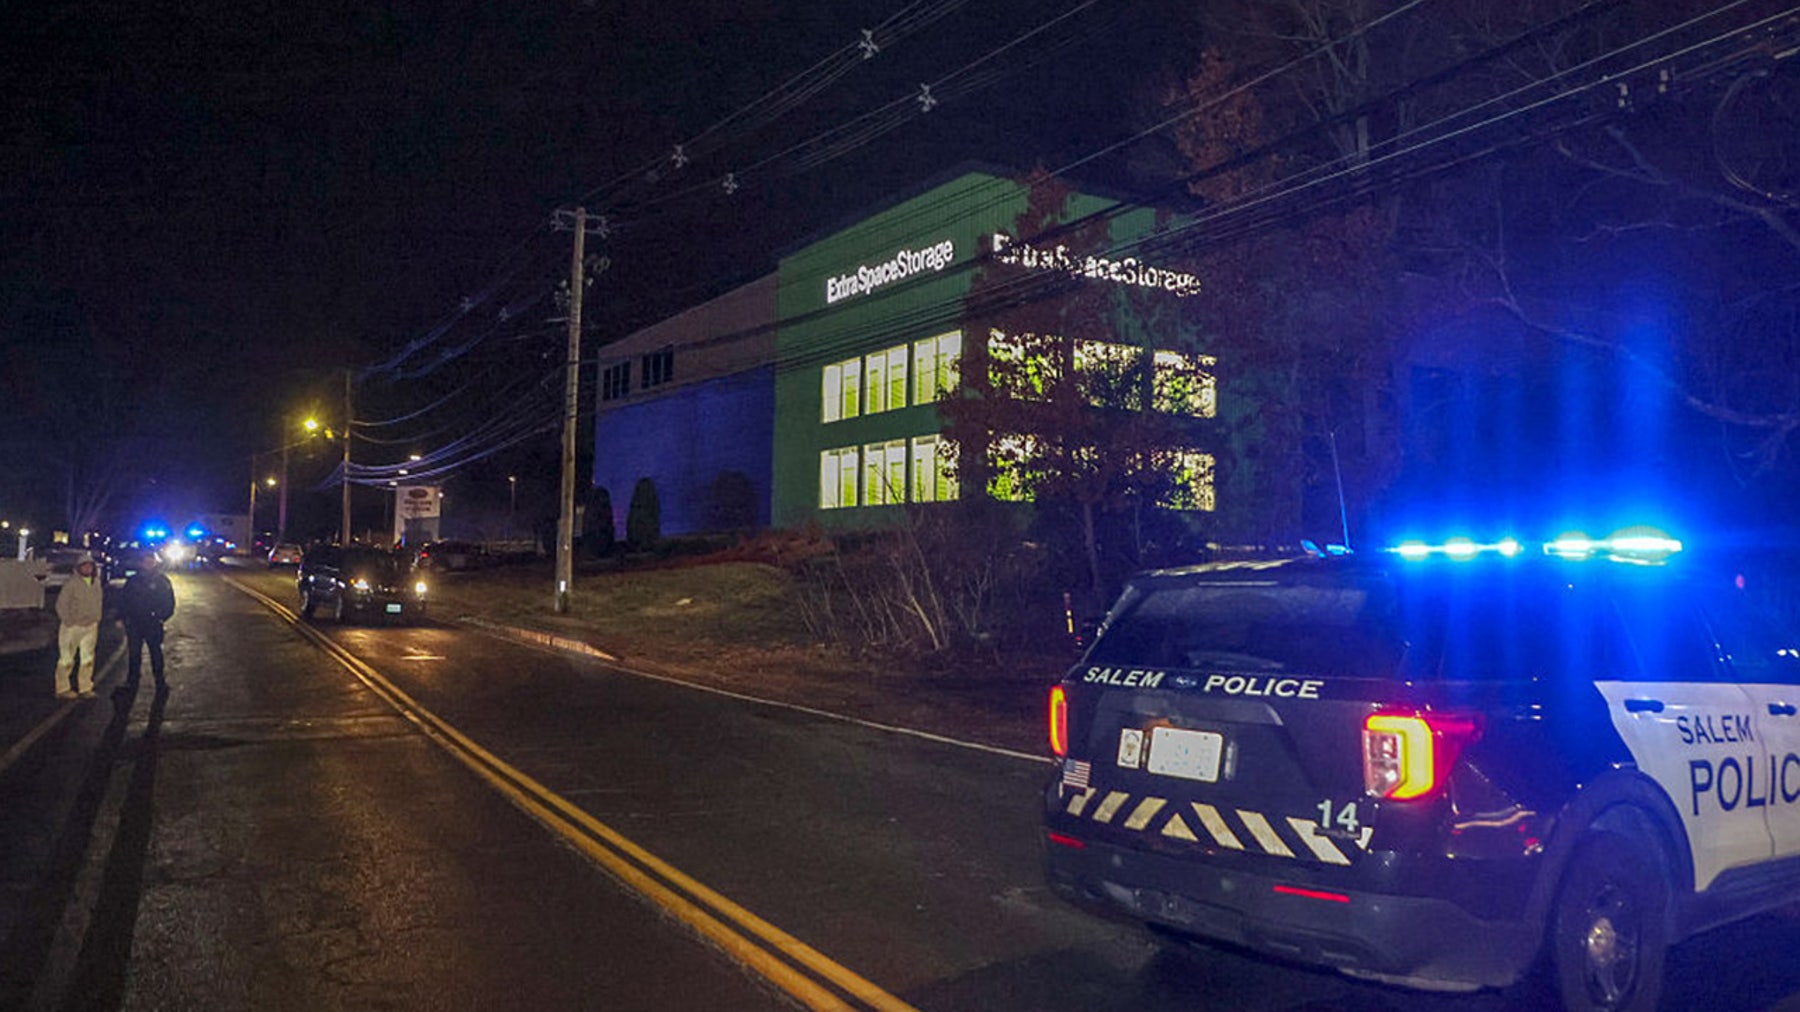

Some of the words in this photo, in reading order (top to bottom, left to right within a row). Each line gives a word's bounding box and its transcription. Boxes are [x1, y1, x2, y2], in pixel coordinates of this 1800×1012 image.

[1084, 667, 1164, 688] SALEM
[1204, 675, 1324, 699] POLICE
[1677, 715, 1754, 744] SALEM
[1317, 800, 1359, 831] 14
